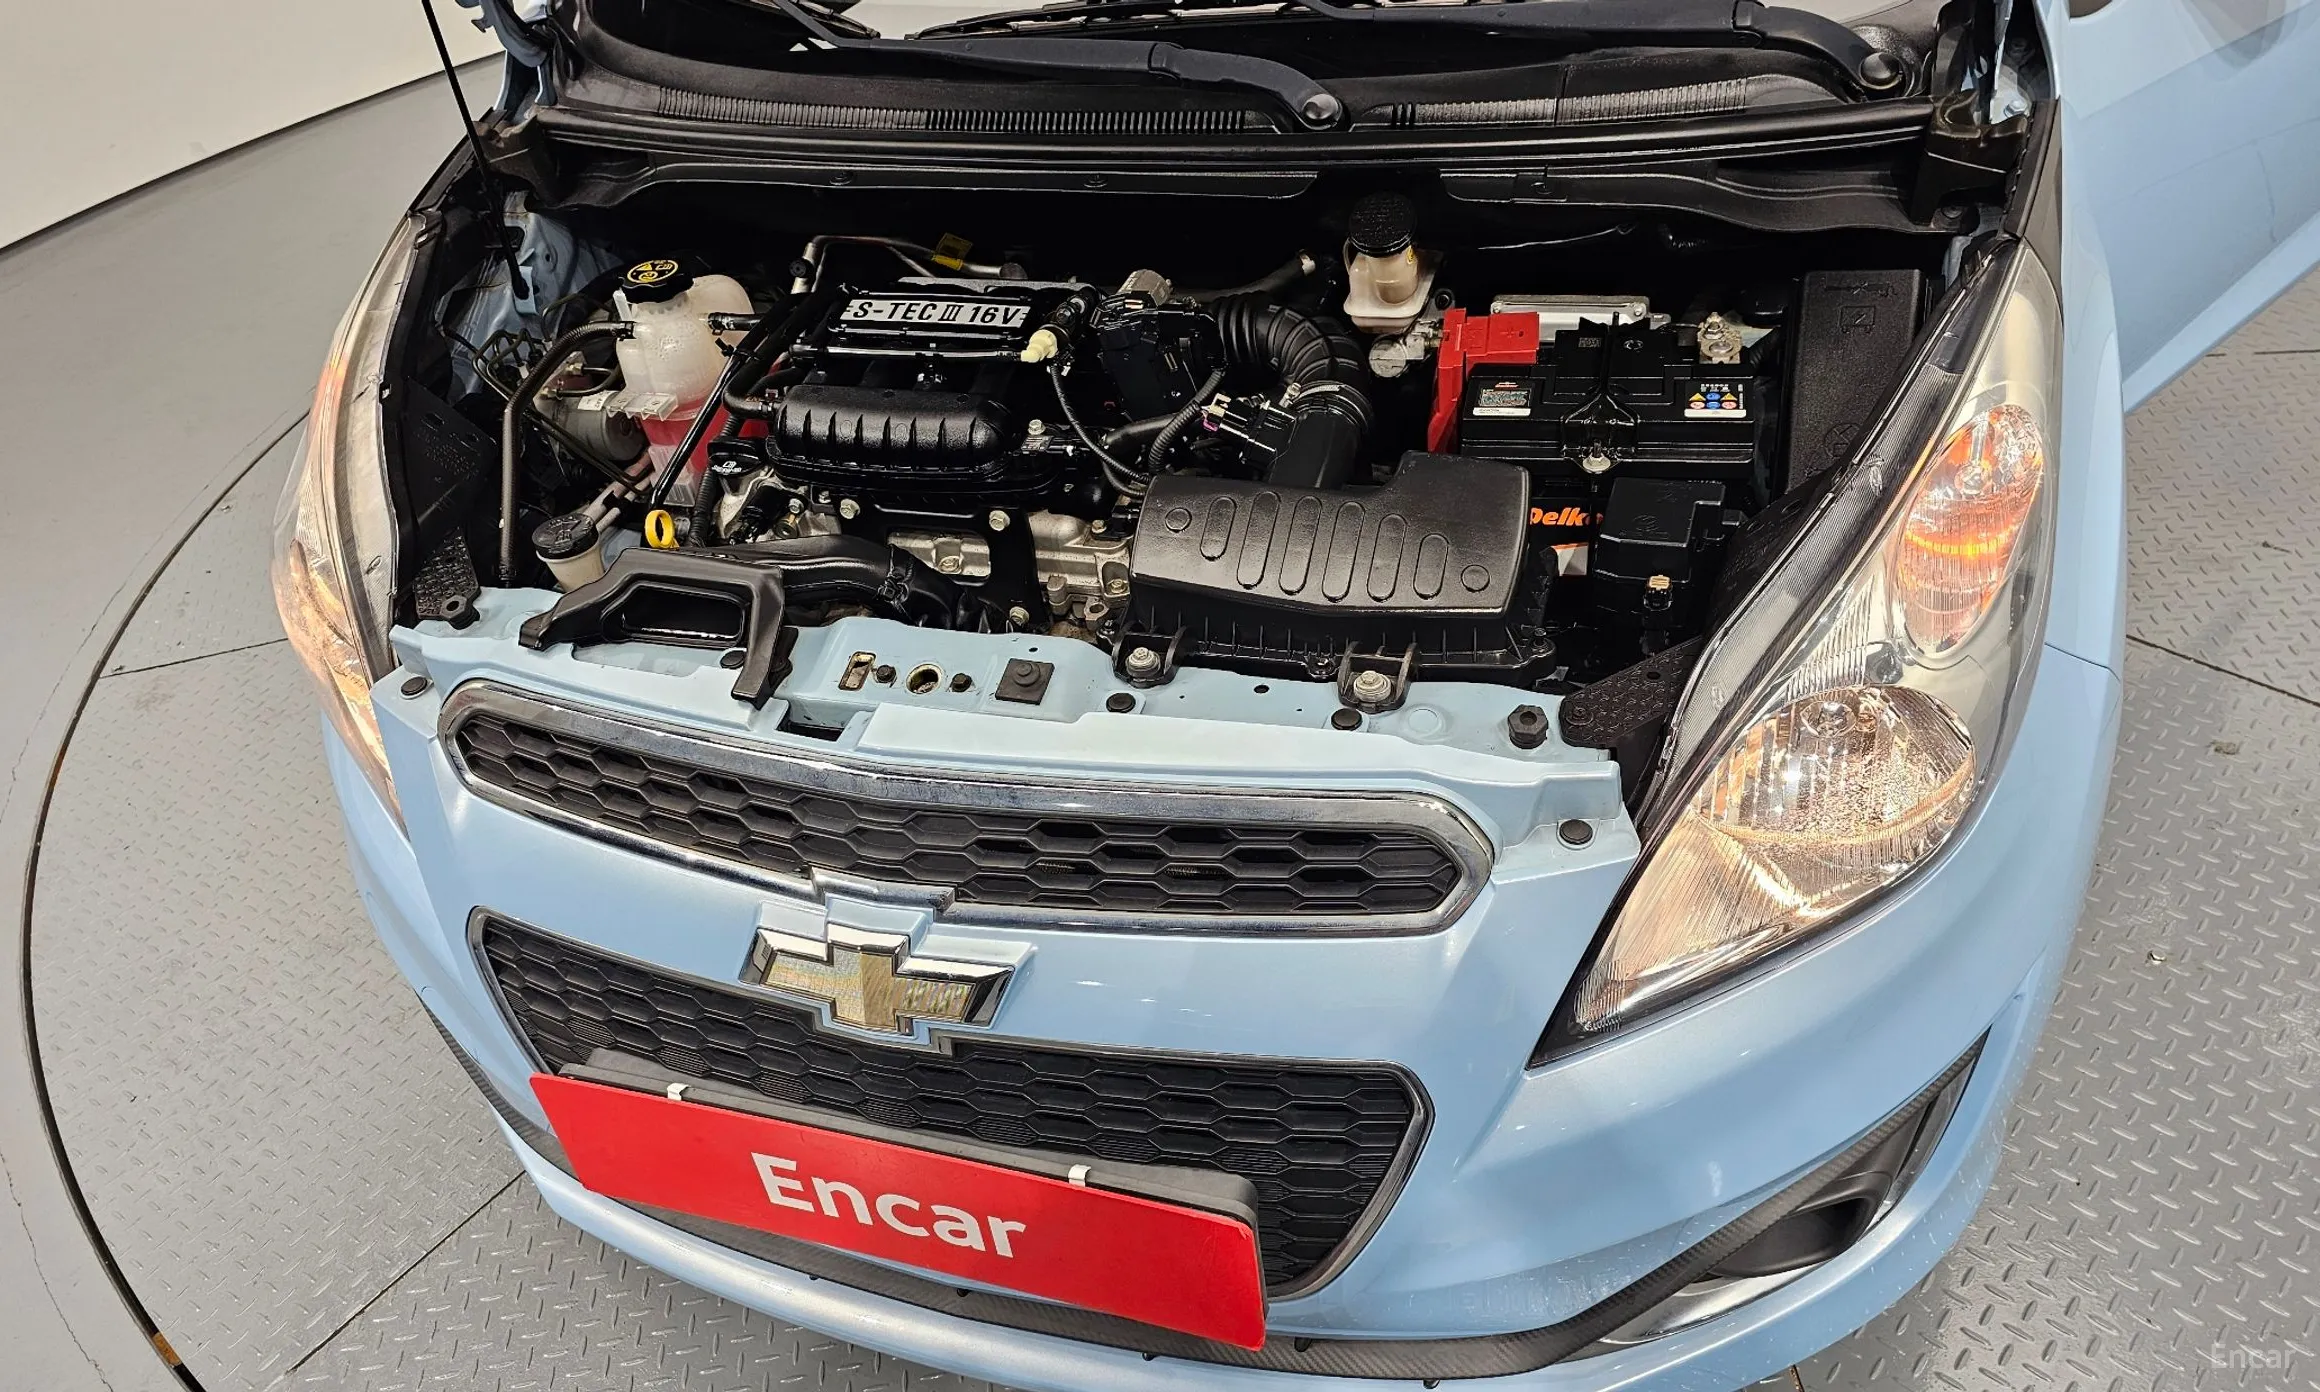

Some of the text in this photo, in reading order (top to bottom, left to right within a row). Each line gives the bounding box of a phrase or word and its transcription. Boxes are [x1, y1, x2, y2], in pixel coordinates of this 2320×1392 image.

[852, 301, 938, 321] S-TEC
[968, 306, 1021, 325] 16V
[750, 1151, 1027, 1259] Encar
